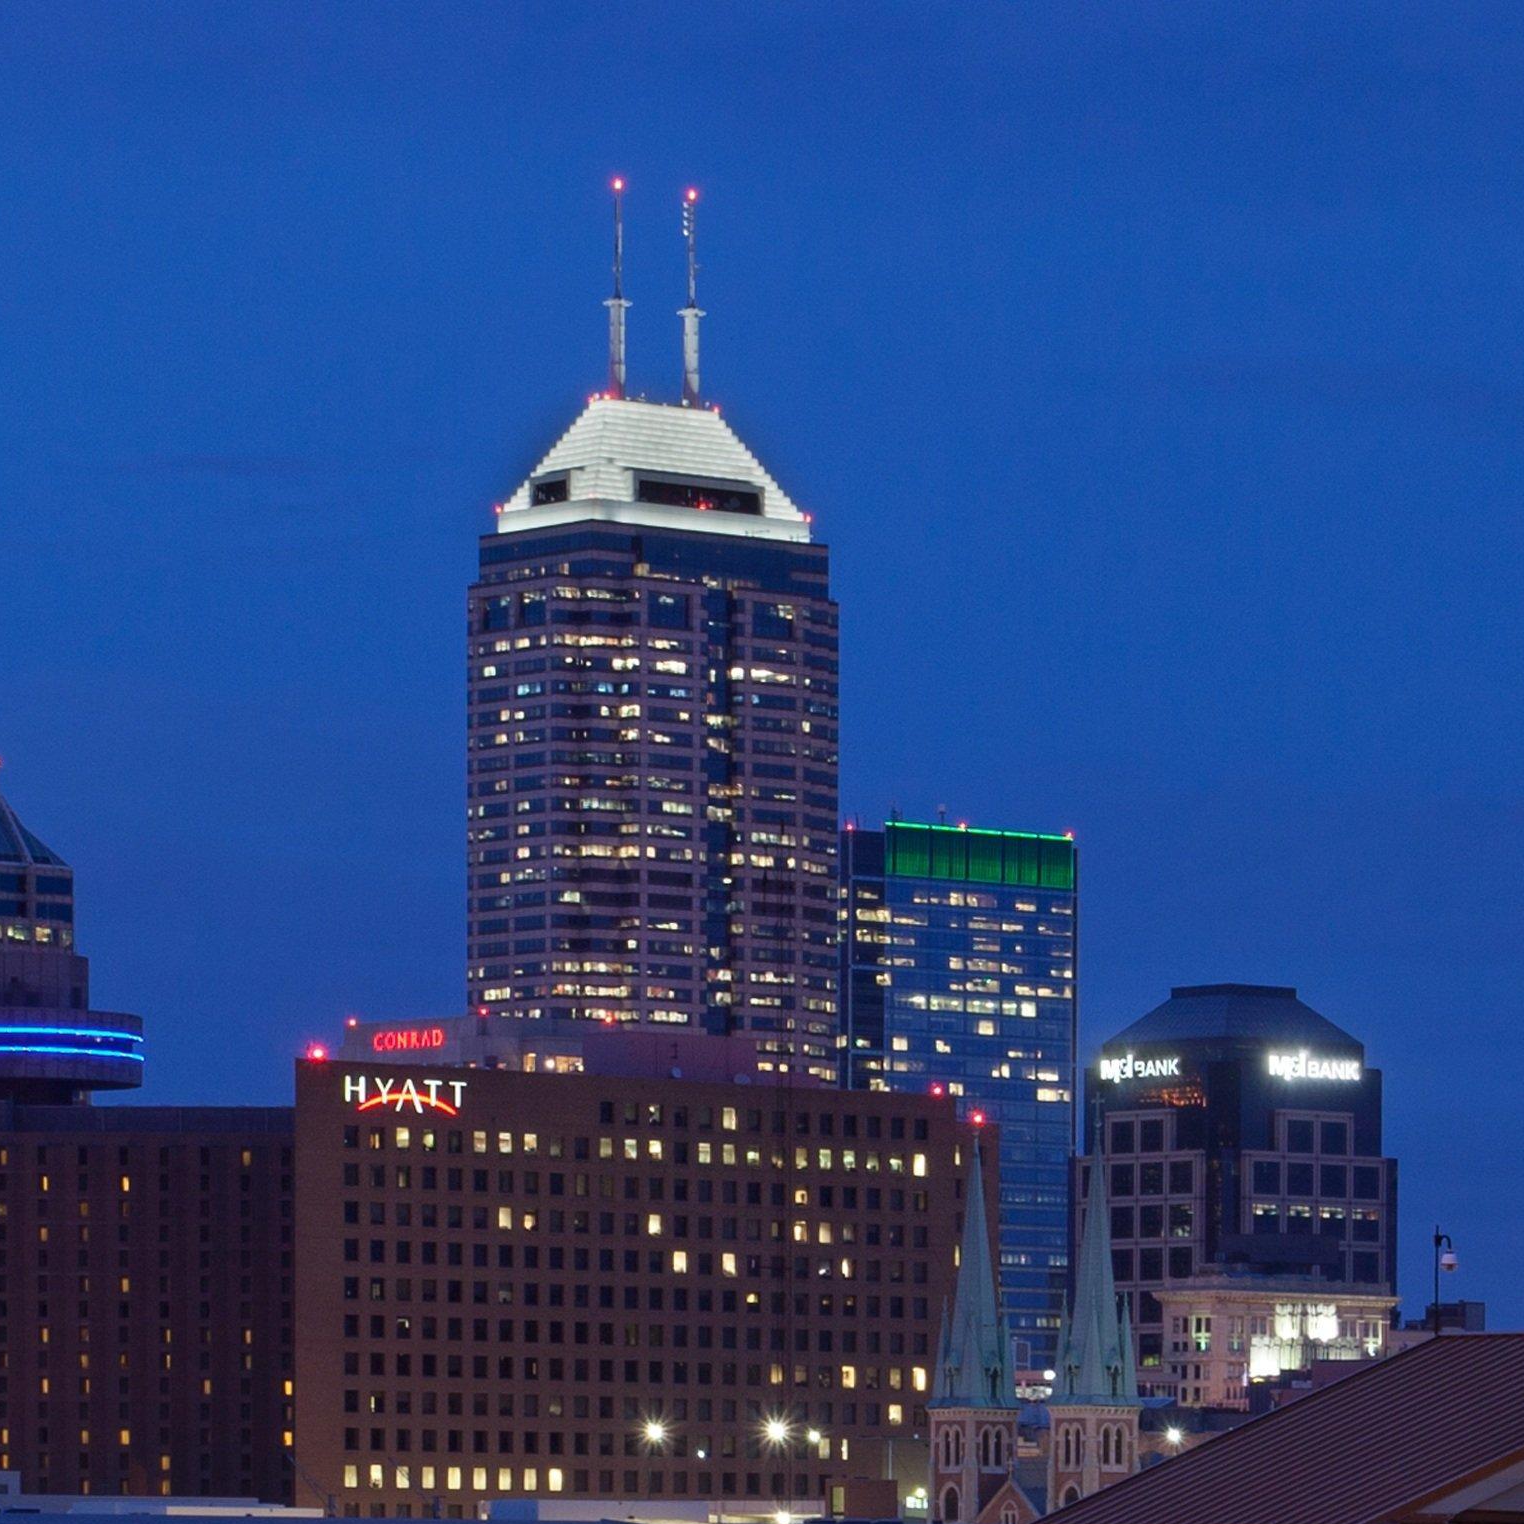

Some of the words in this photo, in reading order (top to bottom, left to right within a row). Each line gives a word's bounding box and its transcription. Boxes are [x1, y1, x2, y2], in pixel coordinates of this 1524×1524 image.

[373, 1029, 444, 1050] CONRAD
[1134, 1058, 1179, 1077] BANK
[1307, 1062, 1361, 1080] BANK
[344, 1075, 467, 1113] HYATT
